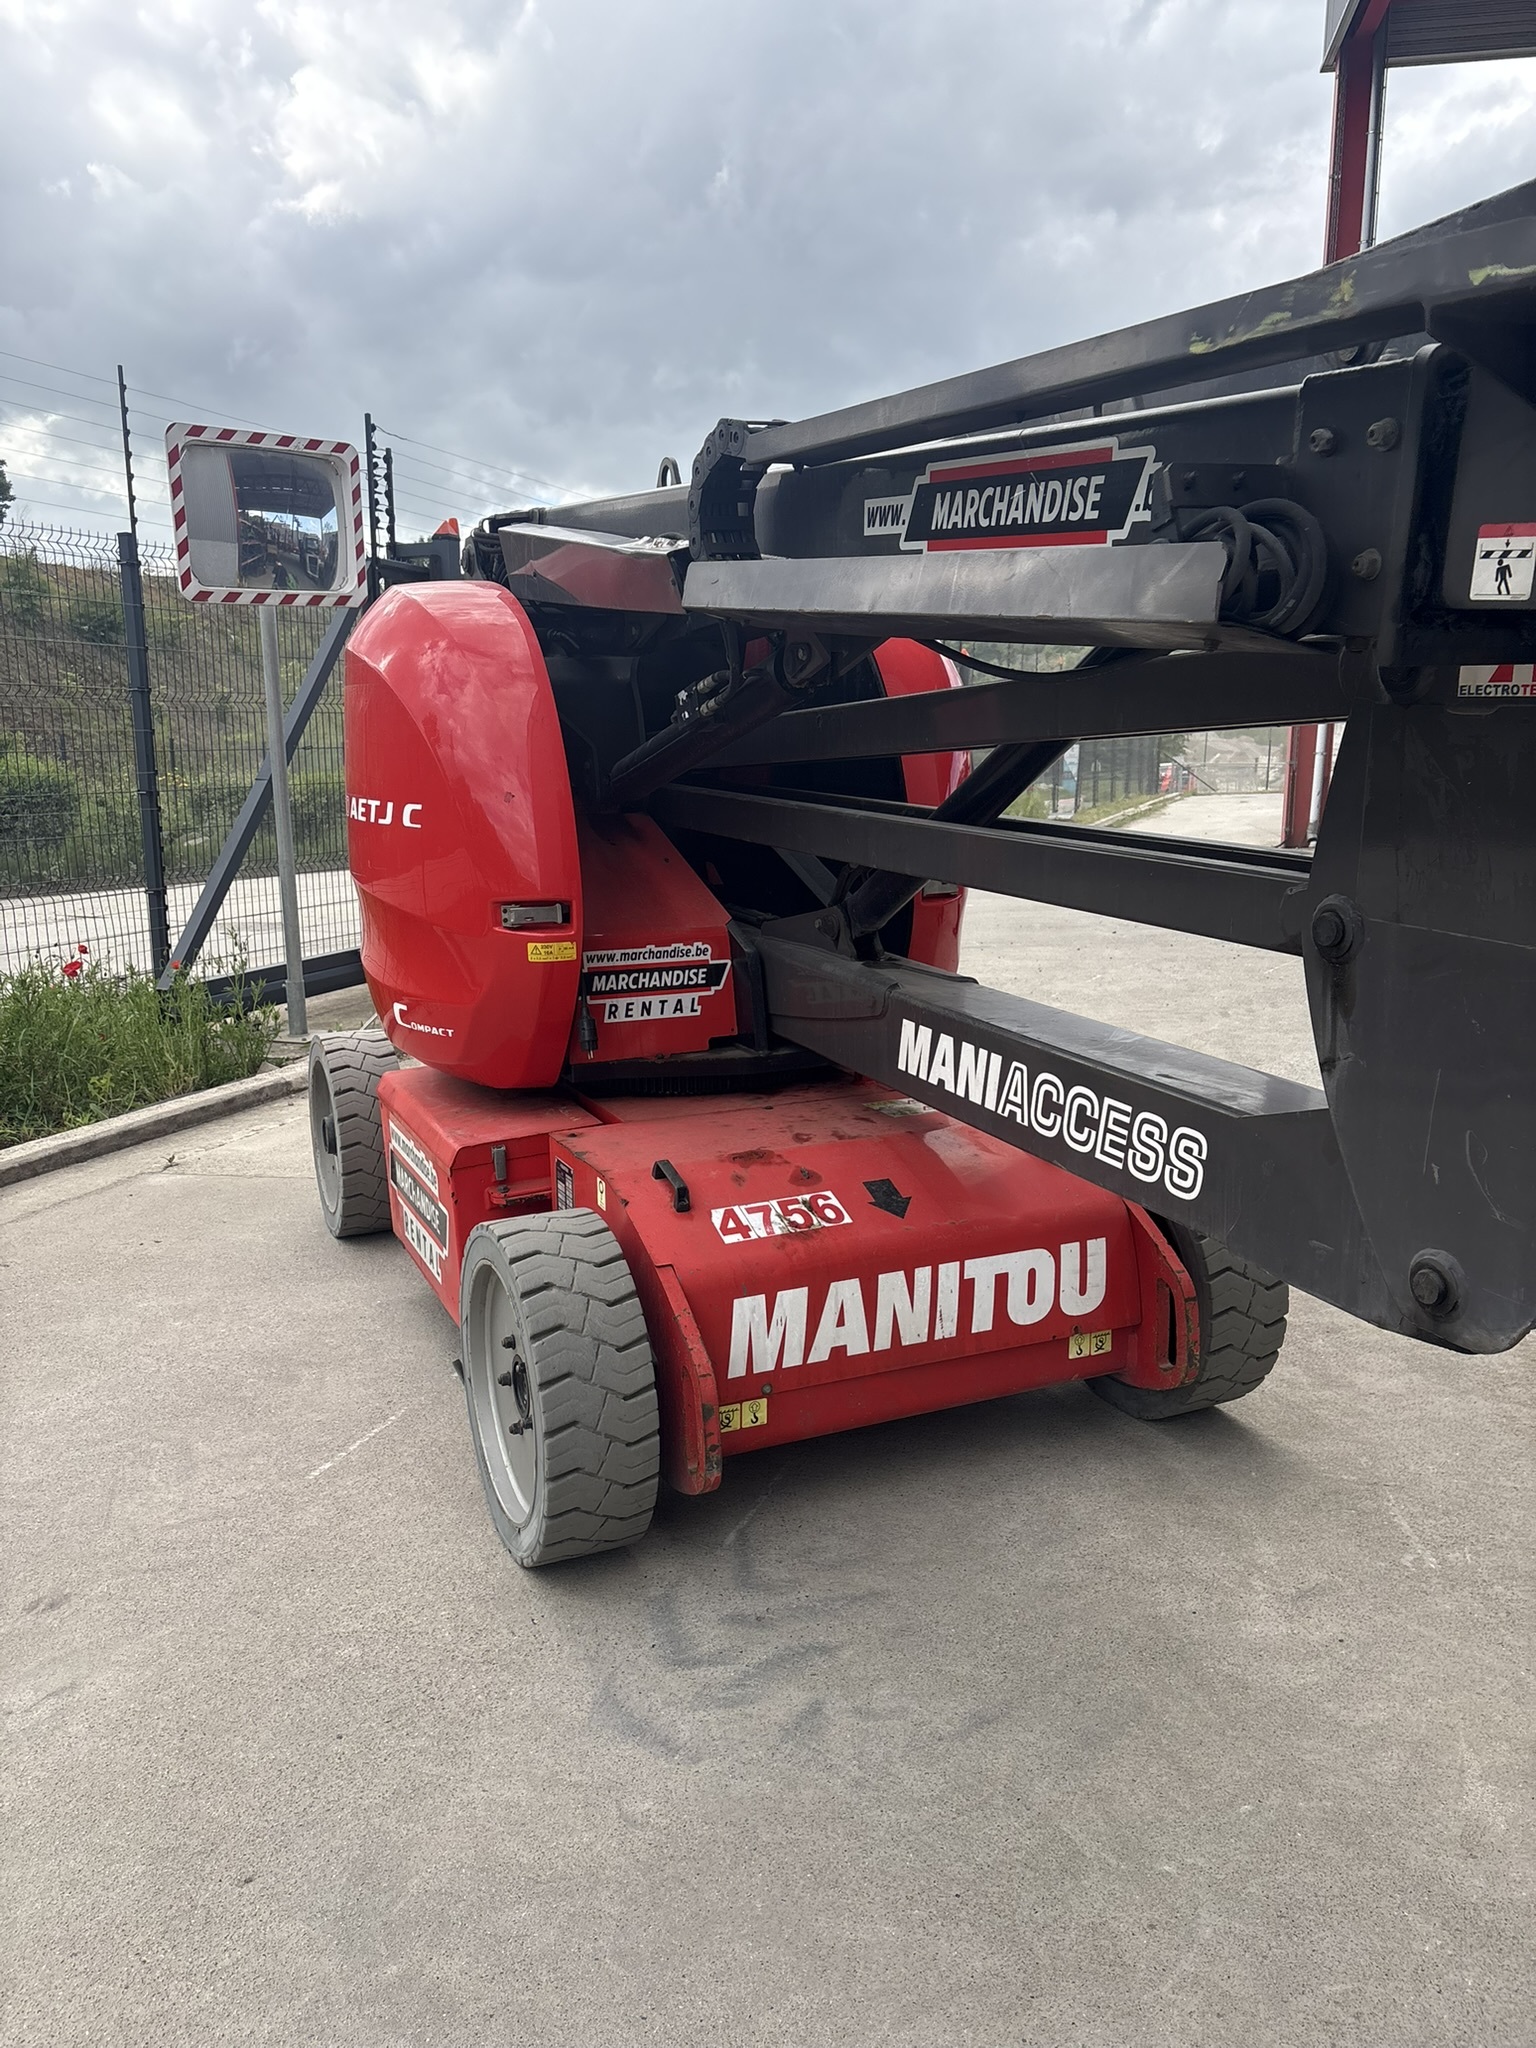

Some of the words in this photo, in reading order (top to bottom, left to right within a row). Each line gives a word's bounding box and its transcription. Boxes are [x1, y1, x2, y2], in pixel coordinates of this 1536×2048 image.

[930, 474, 1106, 531] MARCHANDISE
[402, 803, 423, 829] C
[585, 945, 709, 964] www.marchandise.be
[591, 968, 708, 993] MARCHANDISE
[607, 997, 700, 1020] RENTAL
[897, 1018, 1208, 1201] MANIACCESS
[718, 1192, 846, 1241] 4756
[404, 1207, 441, 1278] RENTAL
[726, 1236, 1108, 1380] MANITOU
